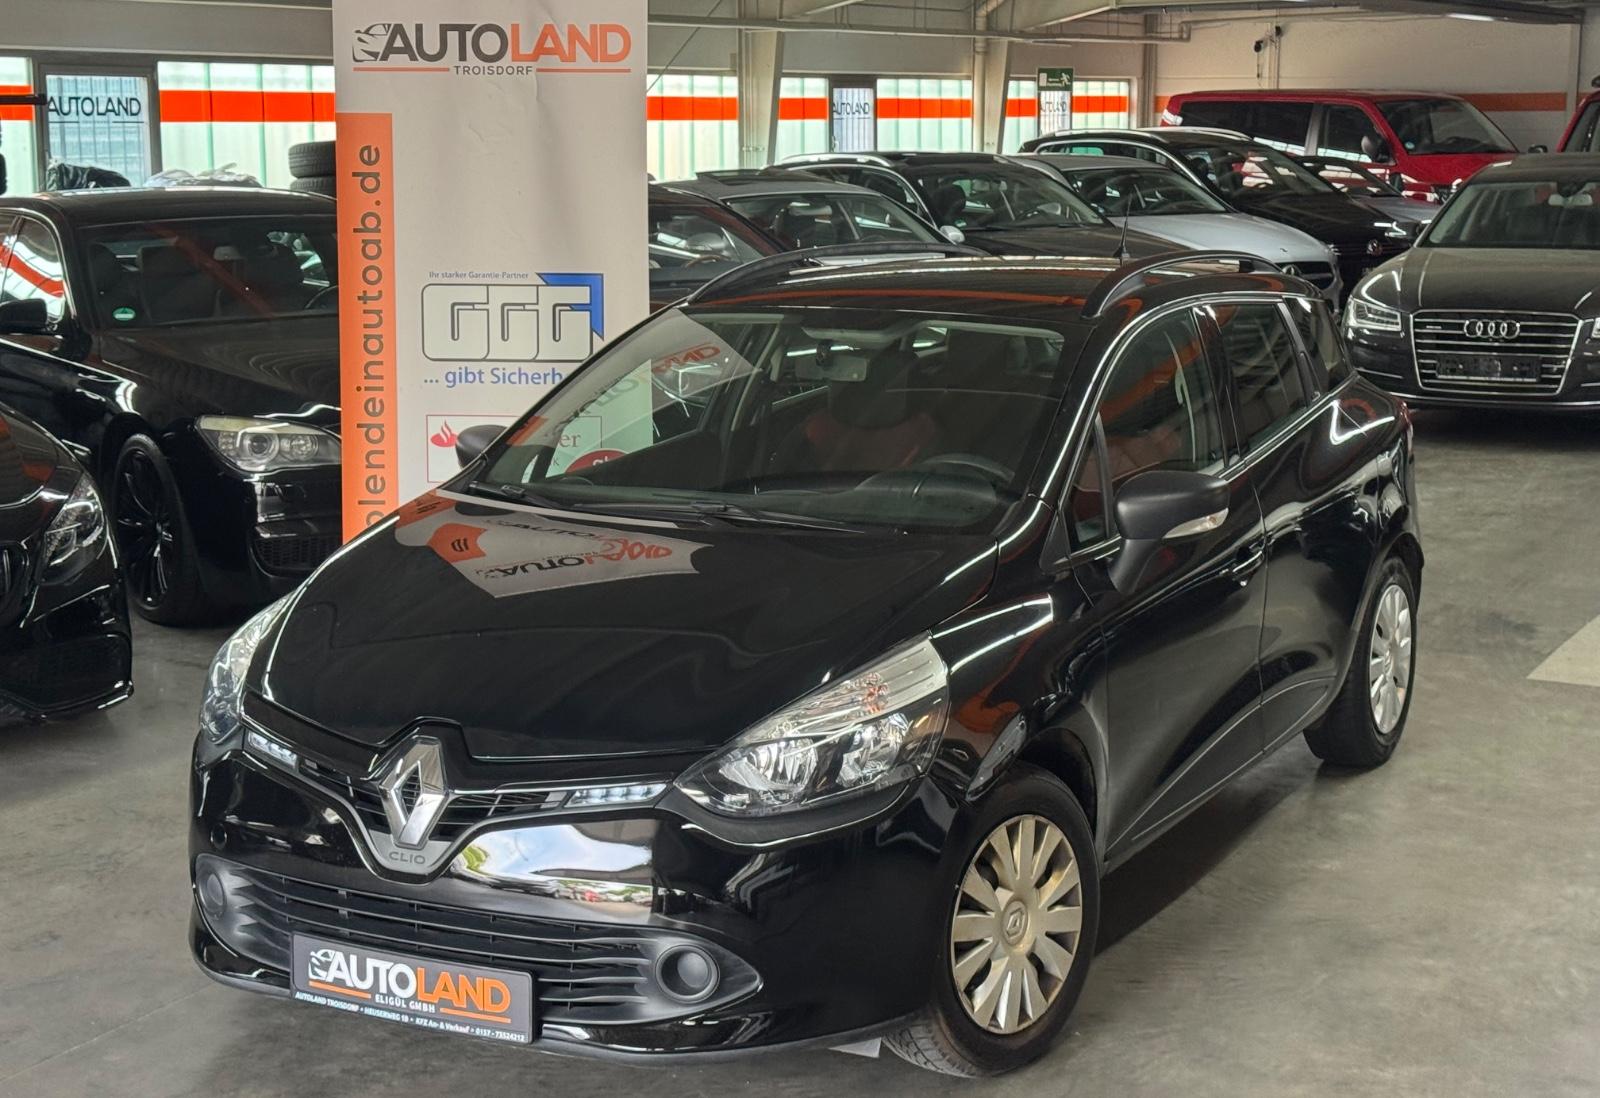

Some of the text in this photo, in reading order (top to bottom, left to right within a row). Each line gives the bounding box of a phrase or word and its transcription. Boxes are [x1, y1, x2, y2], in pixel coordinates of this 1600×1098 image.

[379, 23, 632, 63] AUTOLAND
[453, 65, 534, 76] TROISDORF
[48, 96, 141, 117] AUTOLAND
[429, 271, 440, 279] Ihr
[441, 271, 467, 279] starker
[351, 144, 387, 526] olendeinautoab.de
[445, 366, 485, 388] gibt
[490, 366, 563, 385] Sicherh
[388, 851, 426, 865] CLIO
[326, 951, 511, 1013] AUTOLAND
[294, 991, 327, 1005] AUTOLAND
[327, 998, 360, 1013] TROISDORF
[446, 1022, 470, 1033] Verkauf
[409, 1001, 435, 1014] GMBH
